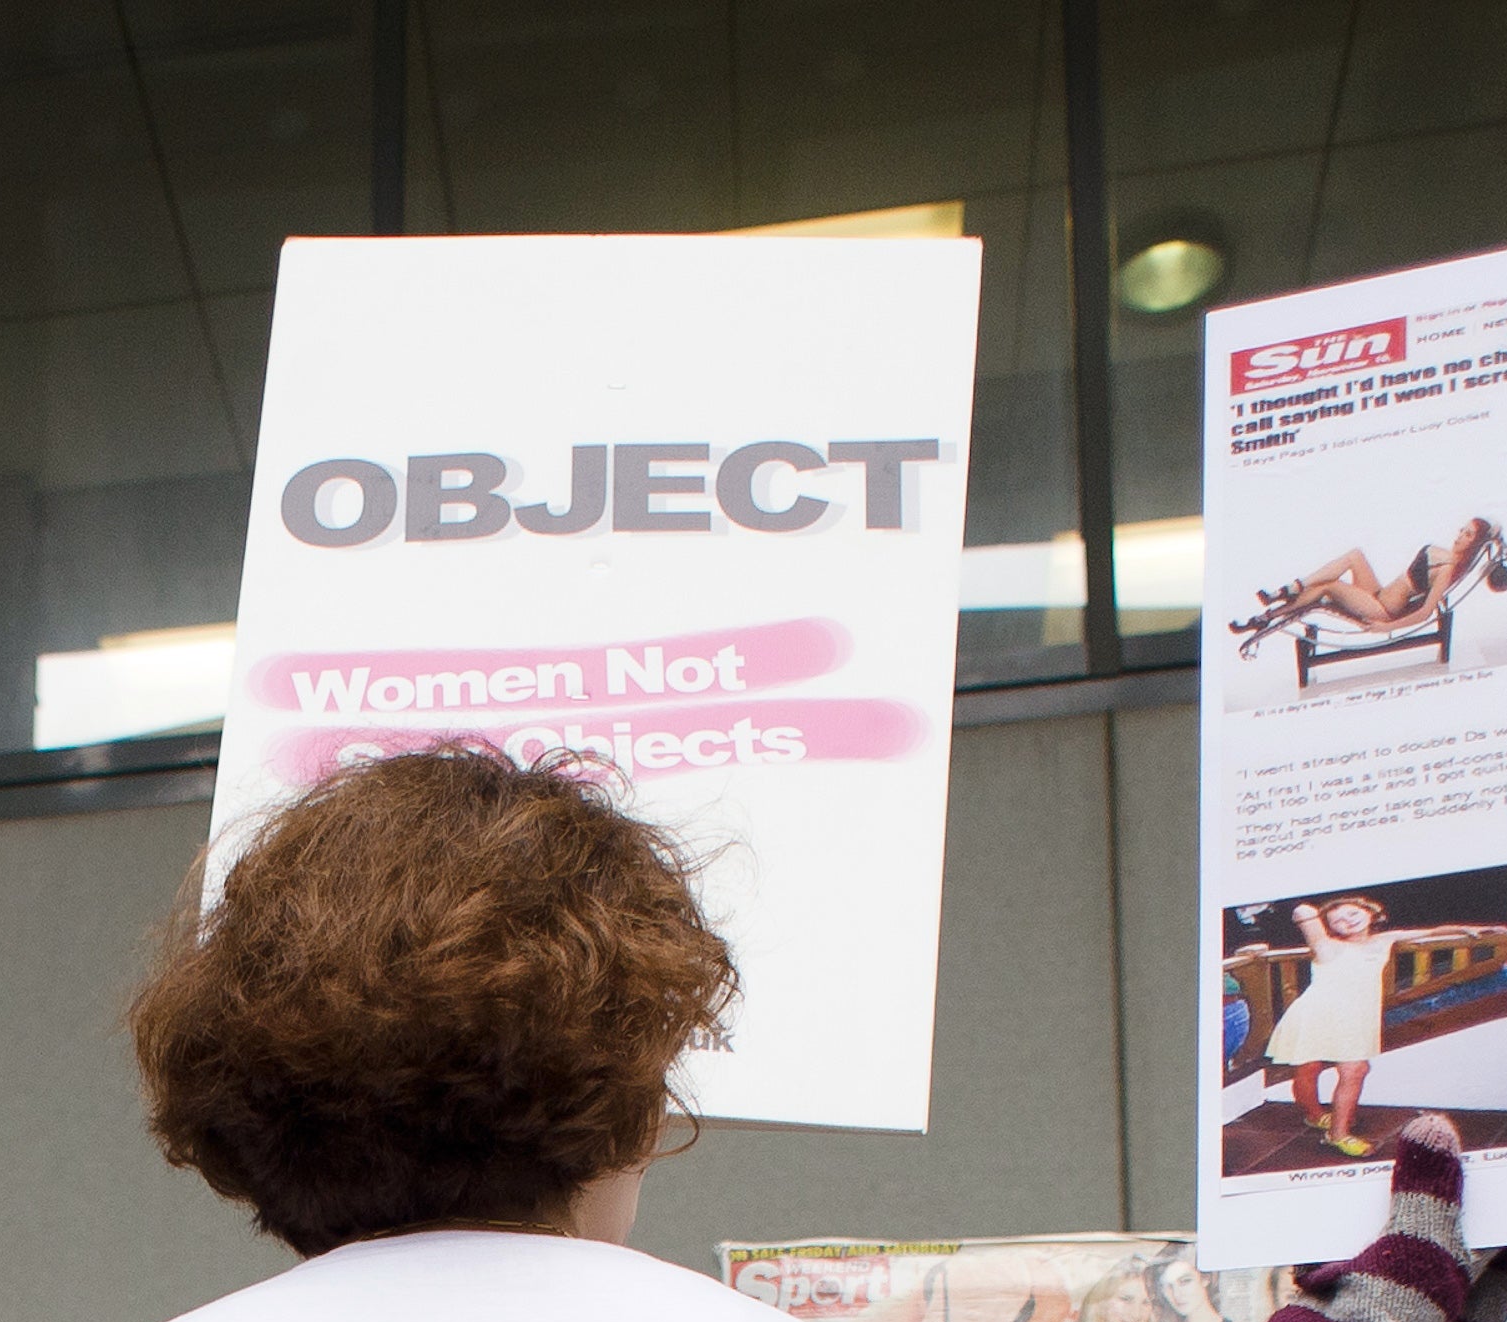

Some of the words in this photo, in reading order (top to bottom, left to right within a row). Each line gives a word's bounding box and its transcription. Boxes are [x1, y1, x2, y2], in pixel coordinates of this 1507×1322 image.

[1245, 331, 1391, 378] Sun
[1231, 416, 1273, 436] call
[1278, 401, 1354, 428] saying
[1394, 384, 1443, 404] won
[1250, 383, 1339, 416] thought
[1380, 365, 1437, 388] have
[1443, 359, 1472, 375] no
[280, 438, 948, 550] OBJECT
[292, 652, 584, 716] Women
[606, 643, 746, 698] Not
[506, 716, 808, 777] Objects
